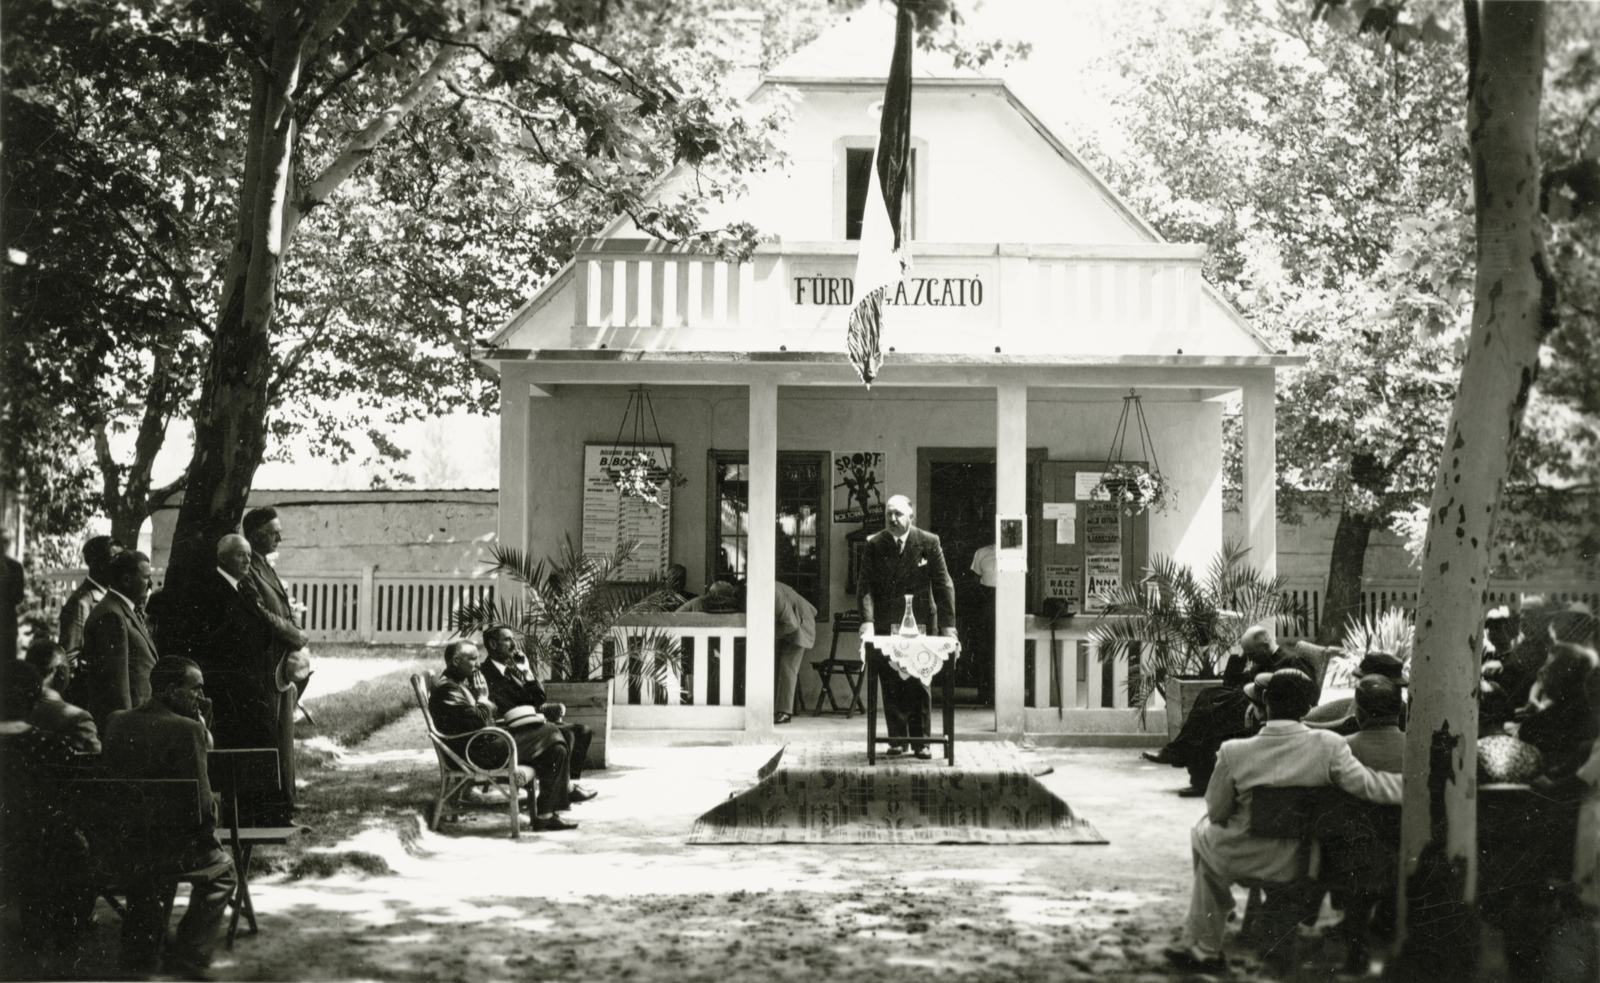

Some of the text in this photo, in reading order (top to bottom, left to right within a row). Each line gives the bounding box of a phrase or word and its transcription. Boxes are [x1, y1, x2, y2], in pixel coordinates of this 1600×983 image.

[1050, 579, 1075, 588] RÁCZ
[1088, 576, 1117, 594] ANNA
[1052, 588, 1073, 596] VALI
